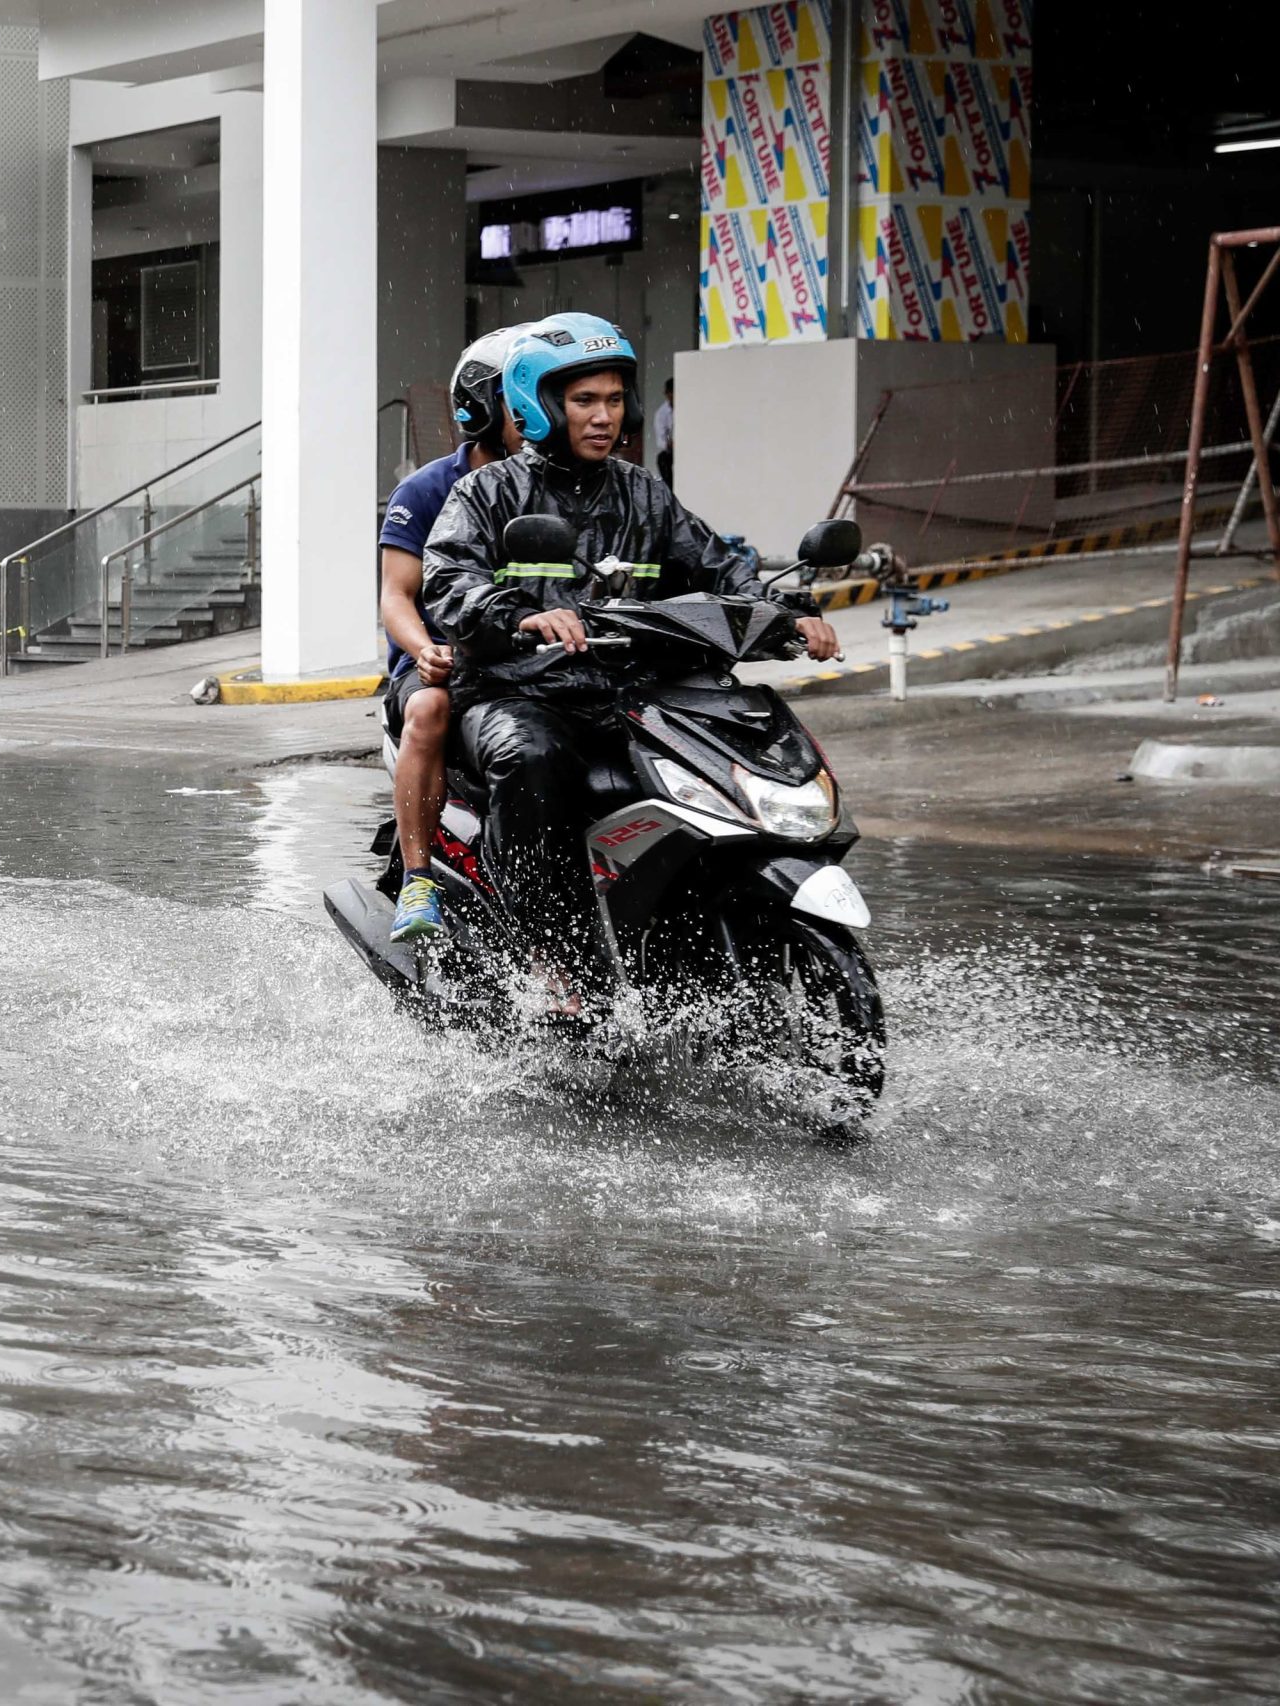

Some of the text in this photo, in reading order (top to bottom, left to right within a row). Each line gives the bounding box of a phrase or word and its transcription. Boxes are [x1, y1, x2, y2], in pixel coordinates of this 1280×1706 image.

[738, 74, 781, 194] FORTUNE
[797, 63, 831, 178] FORTU
[880, 214, 928, 342] FORTUNE
[594, 816, 663, 848] 125
